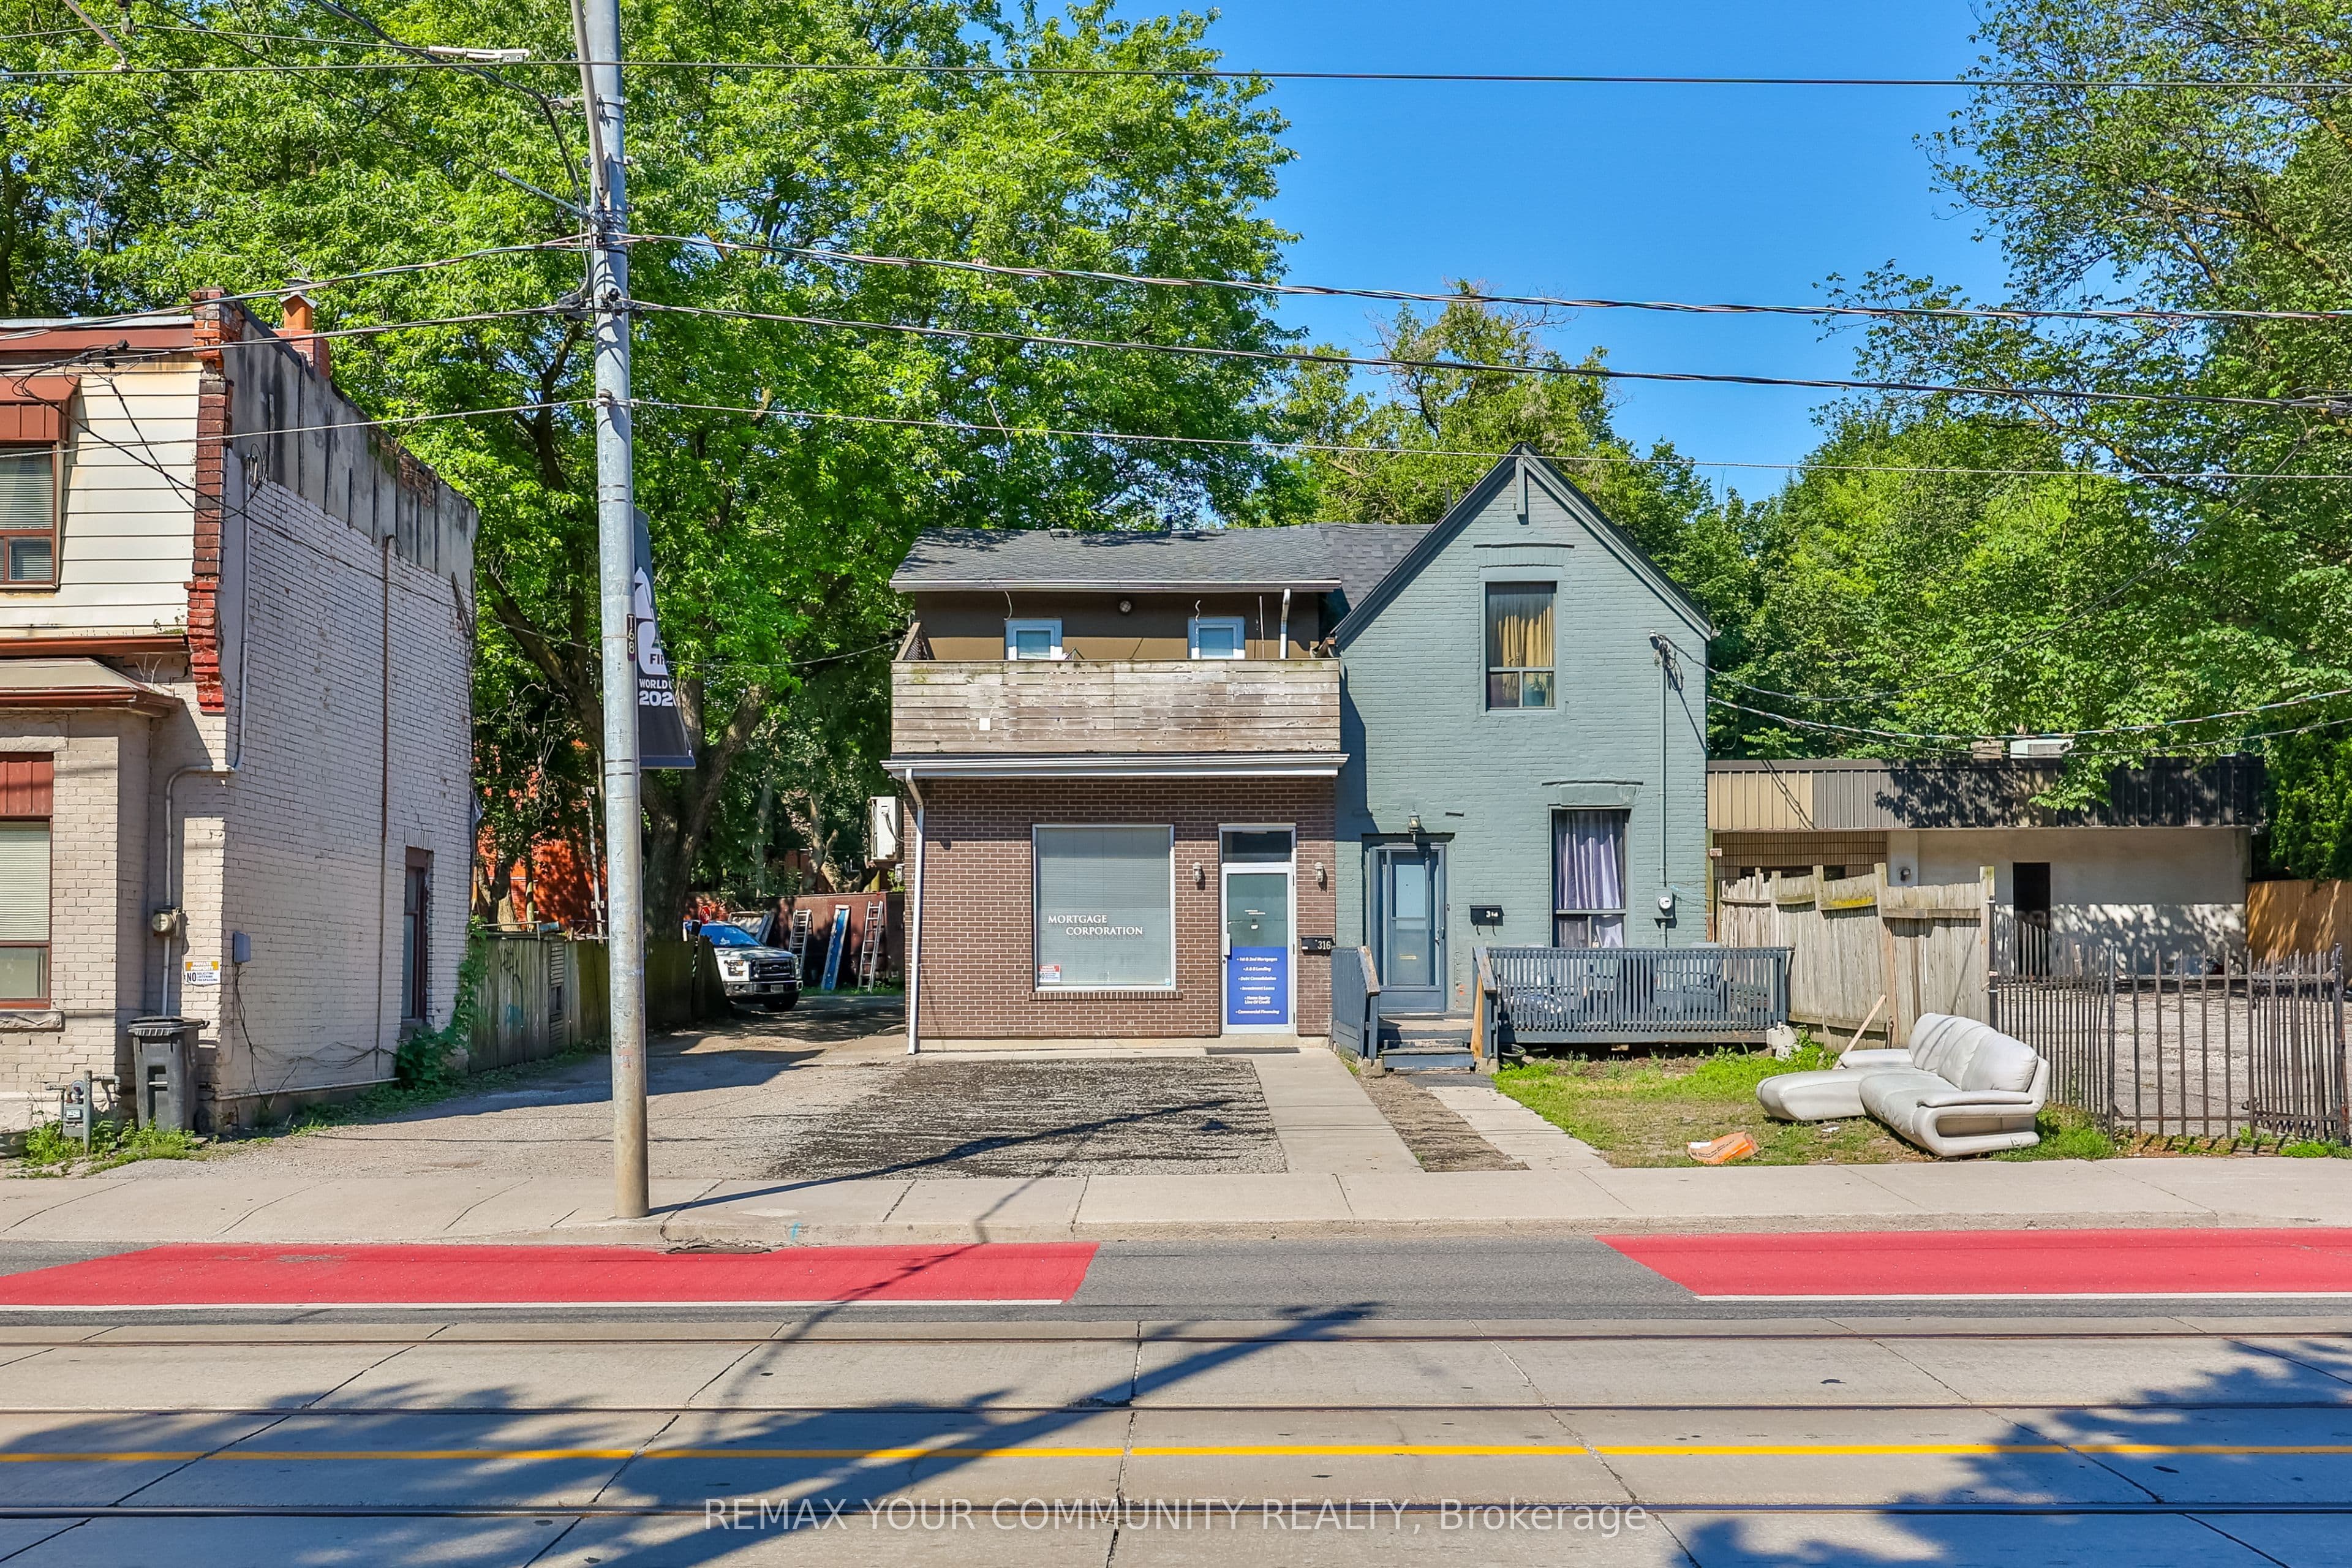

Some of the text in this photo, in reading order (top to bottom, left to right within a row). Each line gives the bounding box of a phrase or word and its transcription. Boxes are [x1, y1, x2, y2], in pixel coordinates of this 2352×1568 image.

[639, 679, 668, 690] WORLD
[1048, 914, 1107, 924] MORTGAGE
[1066, 926, 1143, 935] CORPORATION
[1317, 940, 1331, 950] 316
[187, 972, 196, 982] NO
